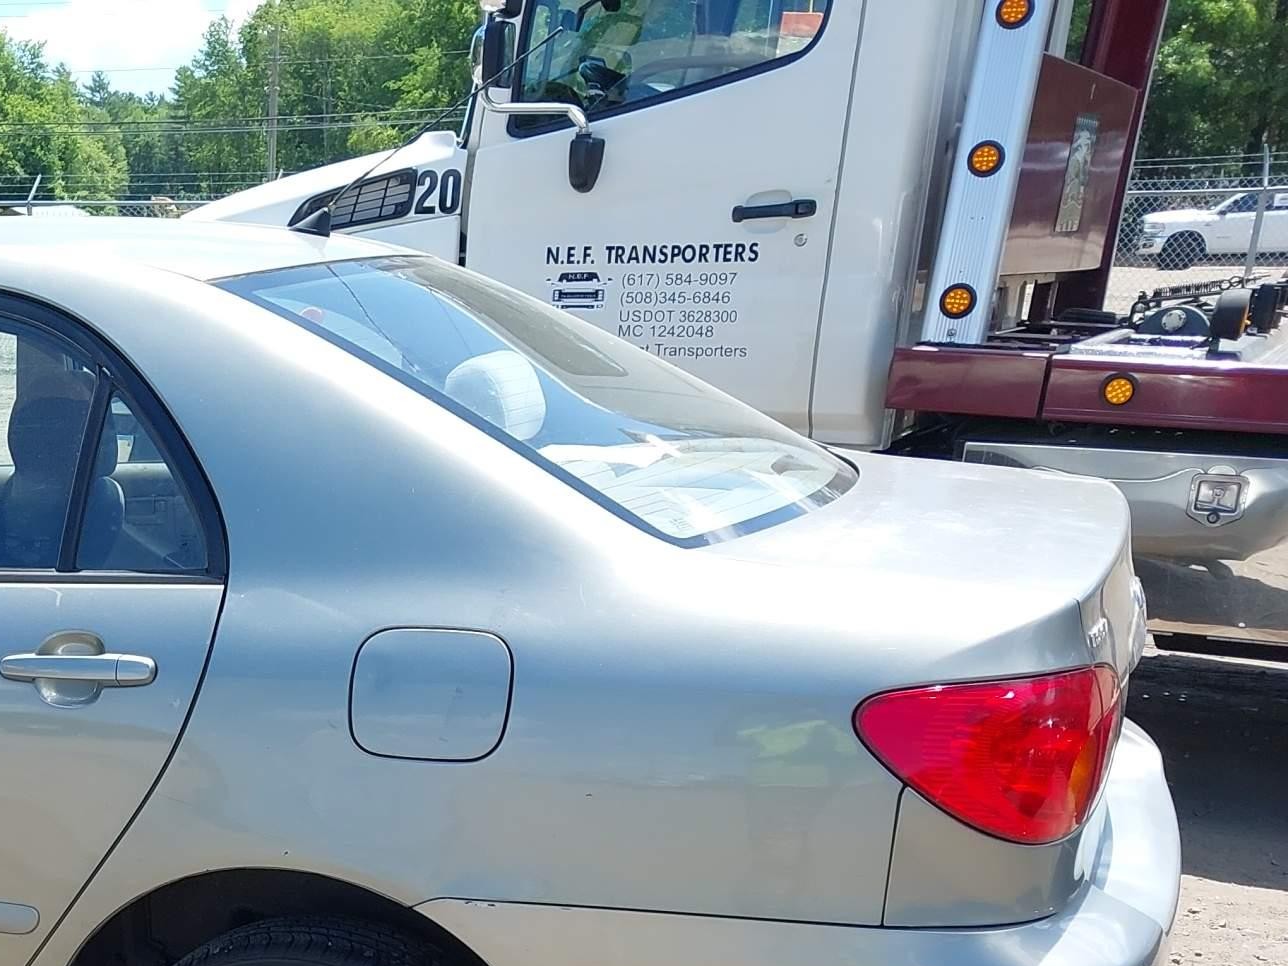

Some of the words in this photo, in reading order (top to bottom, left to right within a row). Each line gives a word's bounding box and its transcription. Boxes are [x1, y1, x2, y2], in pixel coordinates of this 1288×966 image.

[414, 169, 461, 215] 20
[546, 246, 595, 265] N.E.F.
[605, 242, 759, 265] TRANSPORTERS
[622, 273, 660, 289] (617)
[664, 272, 738, 286] 584-9097
[620, 291, 731, 307] (508)345-6846
[619, 309, 675, 322] USDOT
[679, 310, 738, 323] 3628300
[617, 324, 644, 337] MC
[650, 325, 714, 338] 1242048
[654, 343, 748, 359] Transporters
